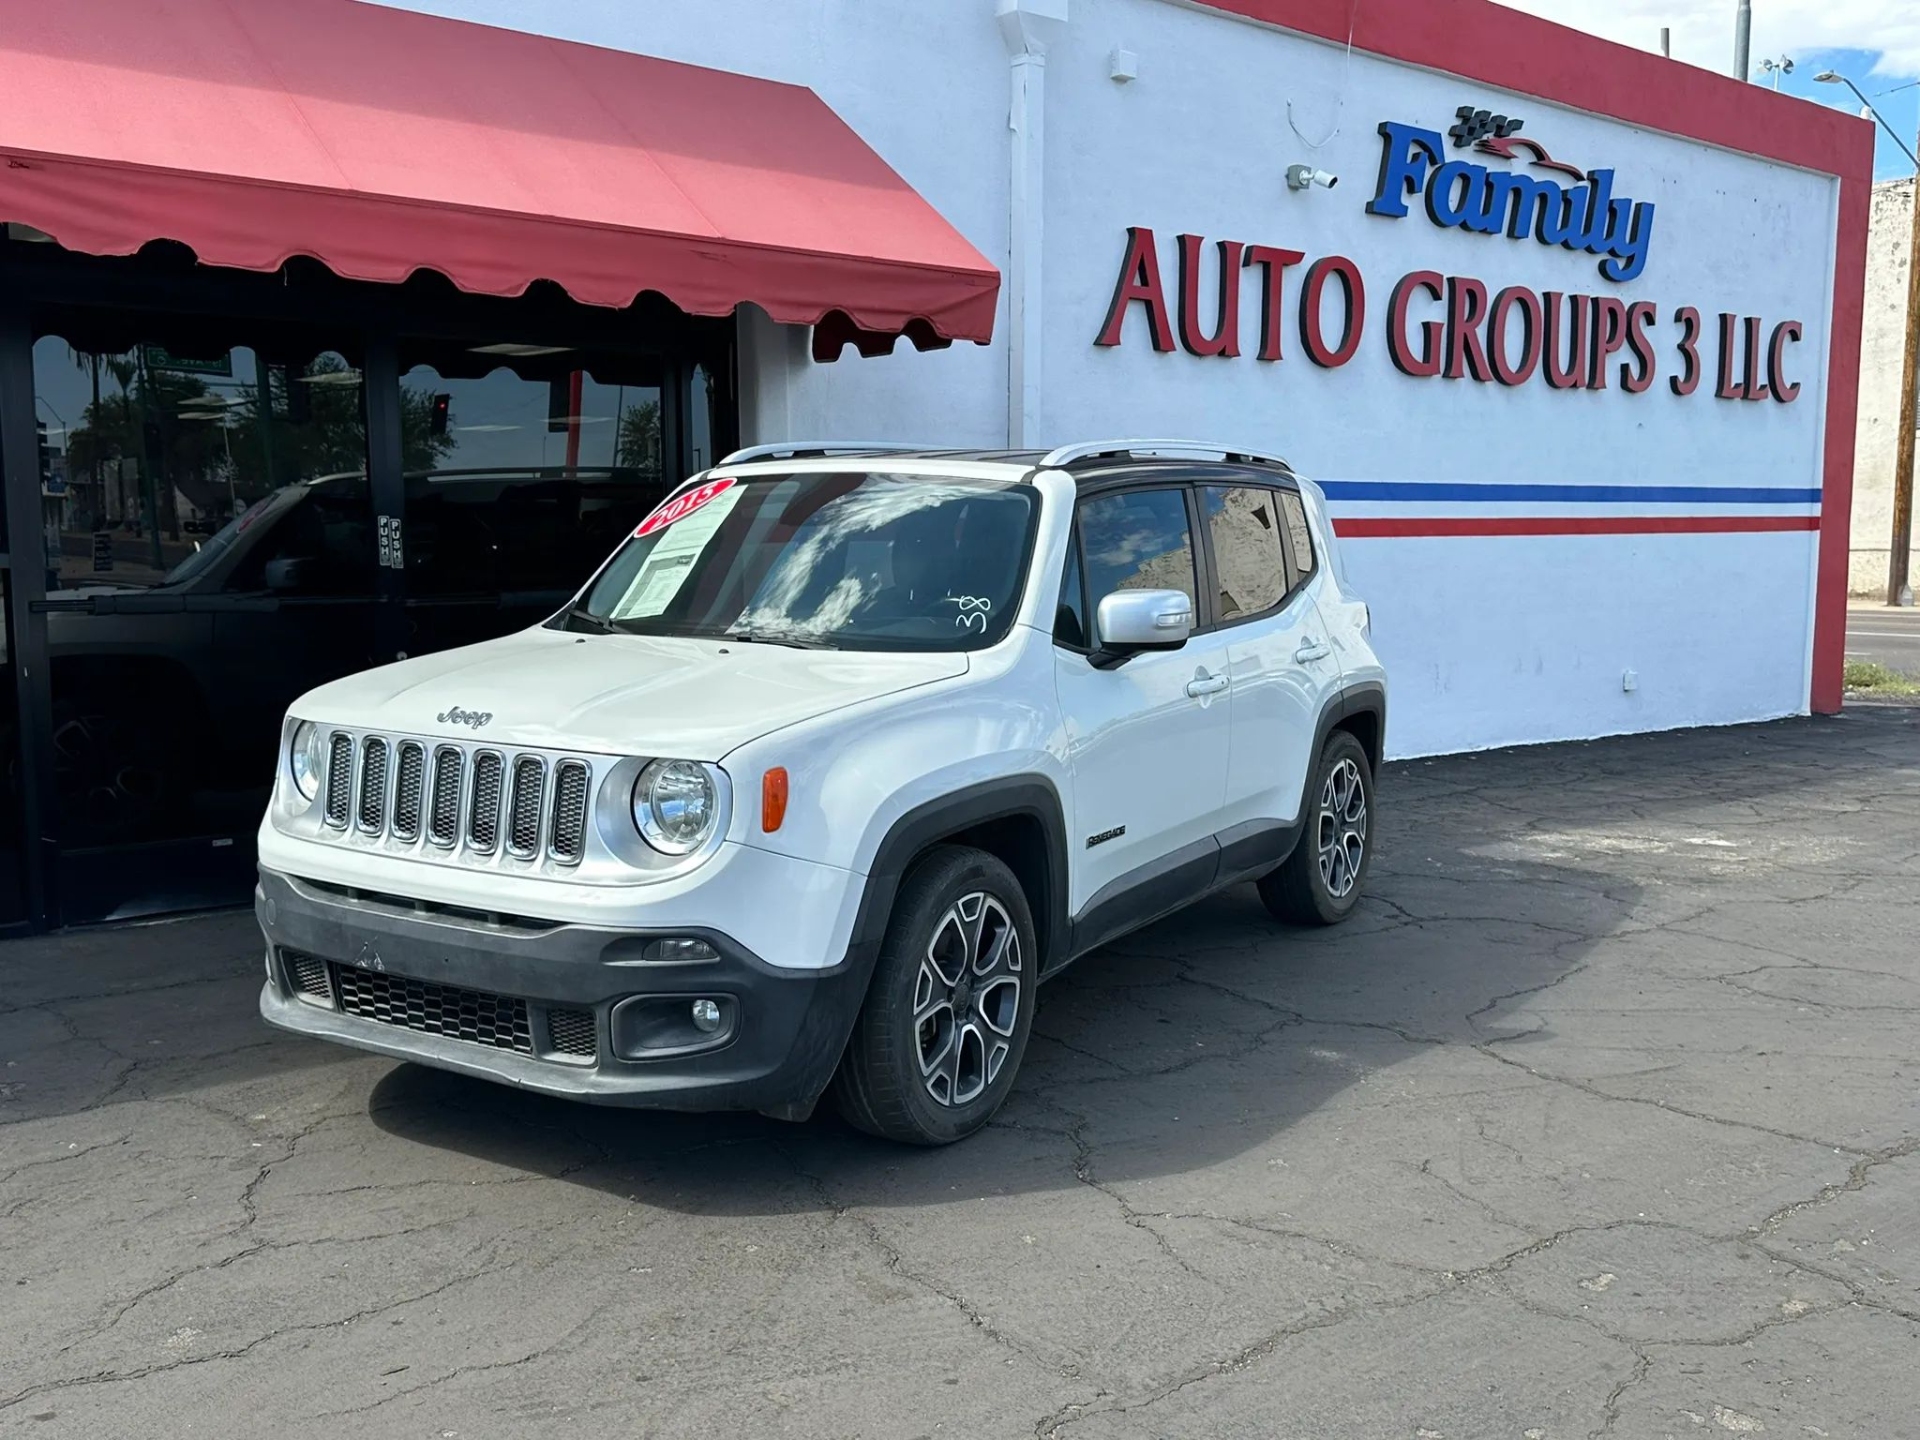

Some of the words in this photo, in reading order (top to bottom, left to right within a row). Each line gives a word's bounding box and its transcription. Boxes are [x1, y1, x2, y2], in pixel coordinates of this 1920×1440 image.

[1366, 120, 1655, 282] Family
[1094, 226, 1366, 368] AUTO
[1386, 270, 1657, 394] GROUPS
[1669, 306, 1701, 395] 3
[1716, 312, 1802, 402] LLC
[650, 482, 718, 530] 2015
[380, 517, 389, 555] PUSH
[391, 521, 401, 559] PUSH
[956, 595, 991, 634] 38
[437, 706, 493, 729] Jeep
